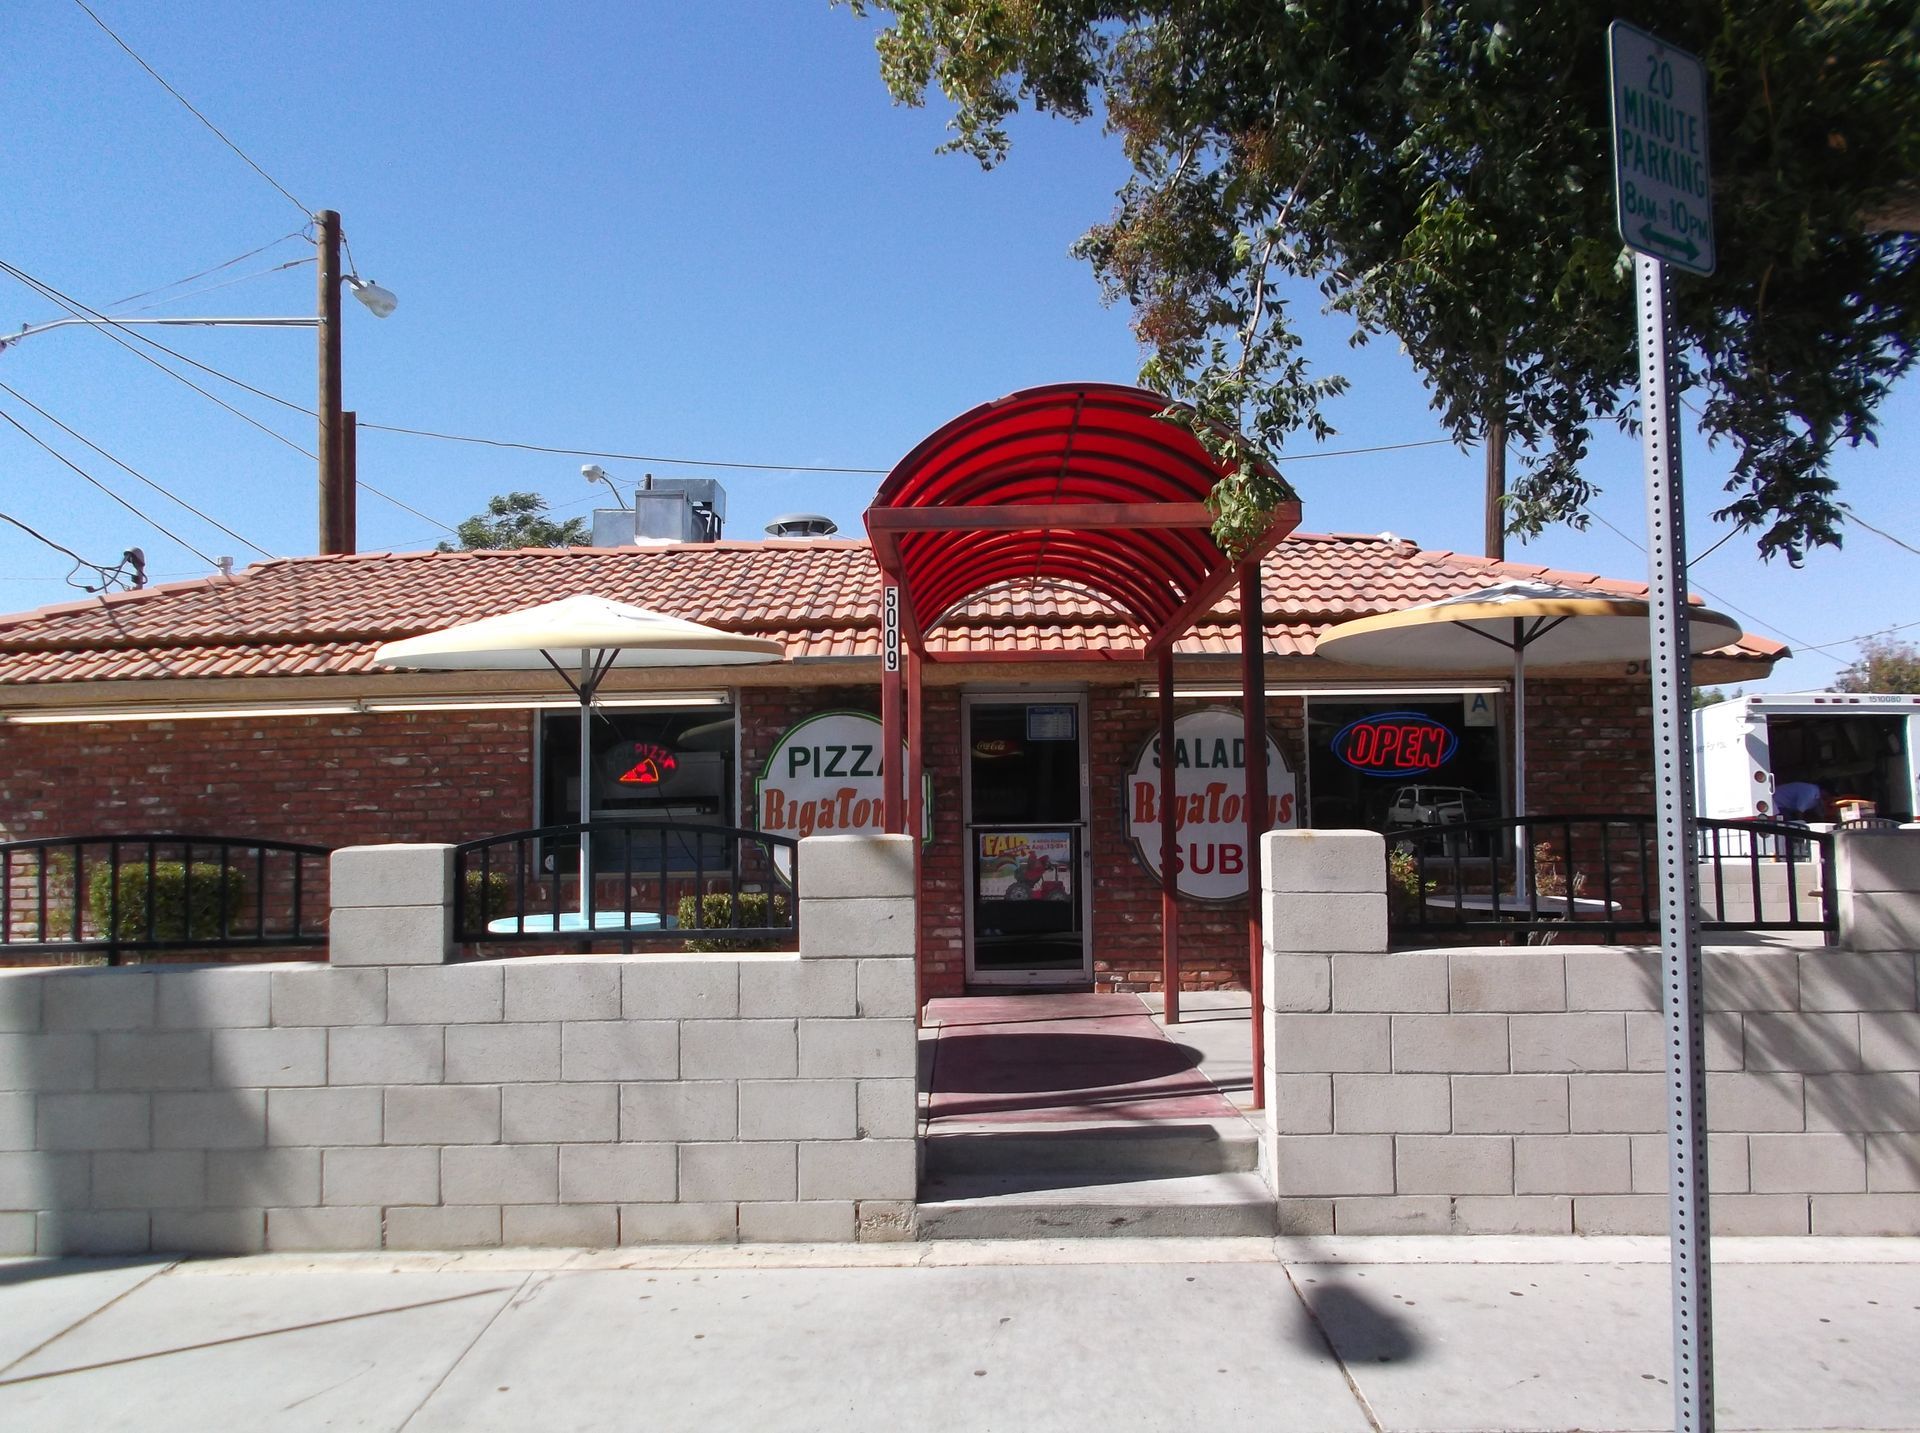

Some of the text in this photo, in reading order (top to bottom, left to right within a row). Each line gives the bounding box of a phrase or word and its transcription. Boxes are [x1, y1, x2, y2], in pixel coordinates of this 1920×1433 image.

[1647, 55, 1673, 99] 20
[1623, 86, 1698, 154] MINUTE
[1621, 129, 1705, 198] PARKING
[886, 587, 897, 670] 5009
[1471, 693, 1489, 713] A
[1868, 695, 1902, 703] 1510080
[633, 743, 676, 769] PIZZA
[788, 744, 904, 778] PIZZ
[1152, 738, 1271, 768] SALAD
[1347, 724, 1446, 768] OPEN
[762, 787, 924, 837] RigaTon
[1133, 782, 1294, 832] RgaToys
